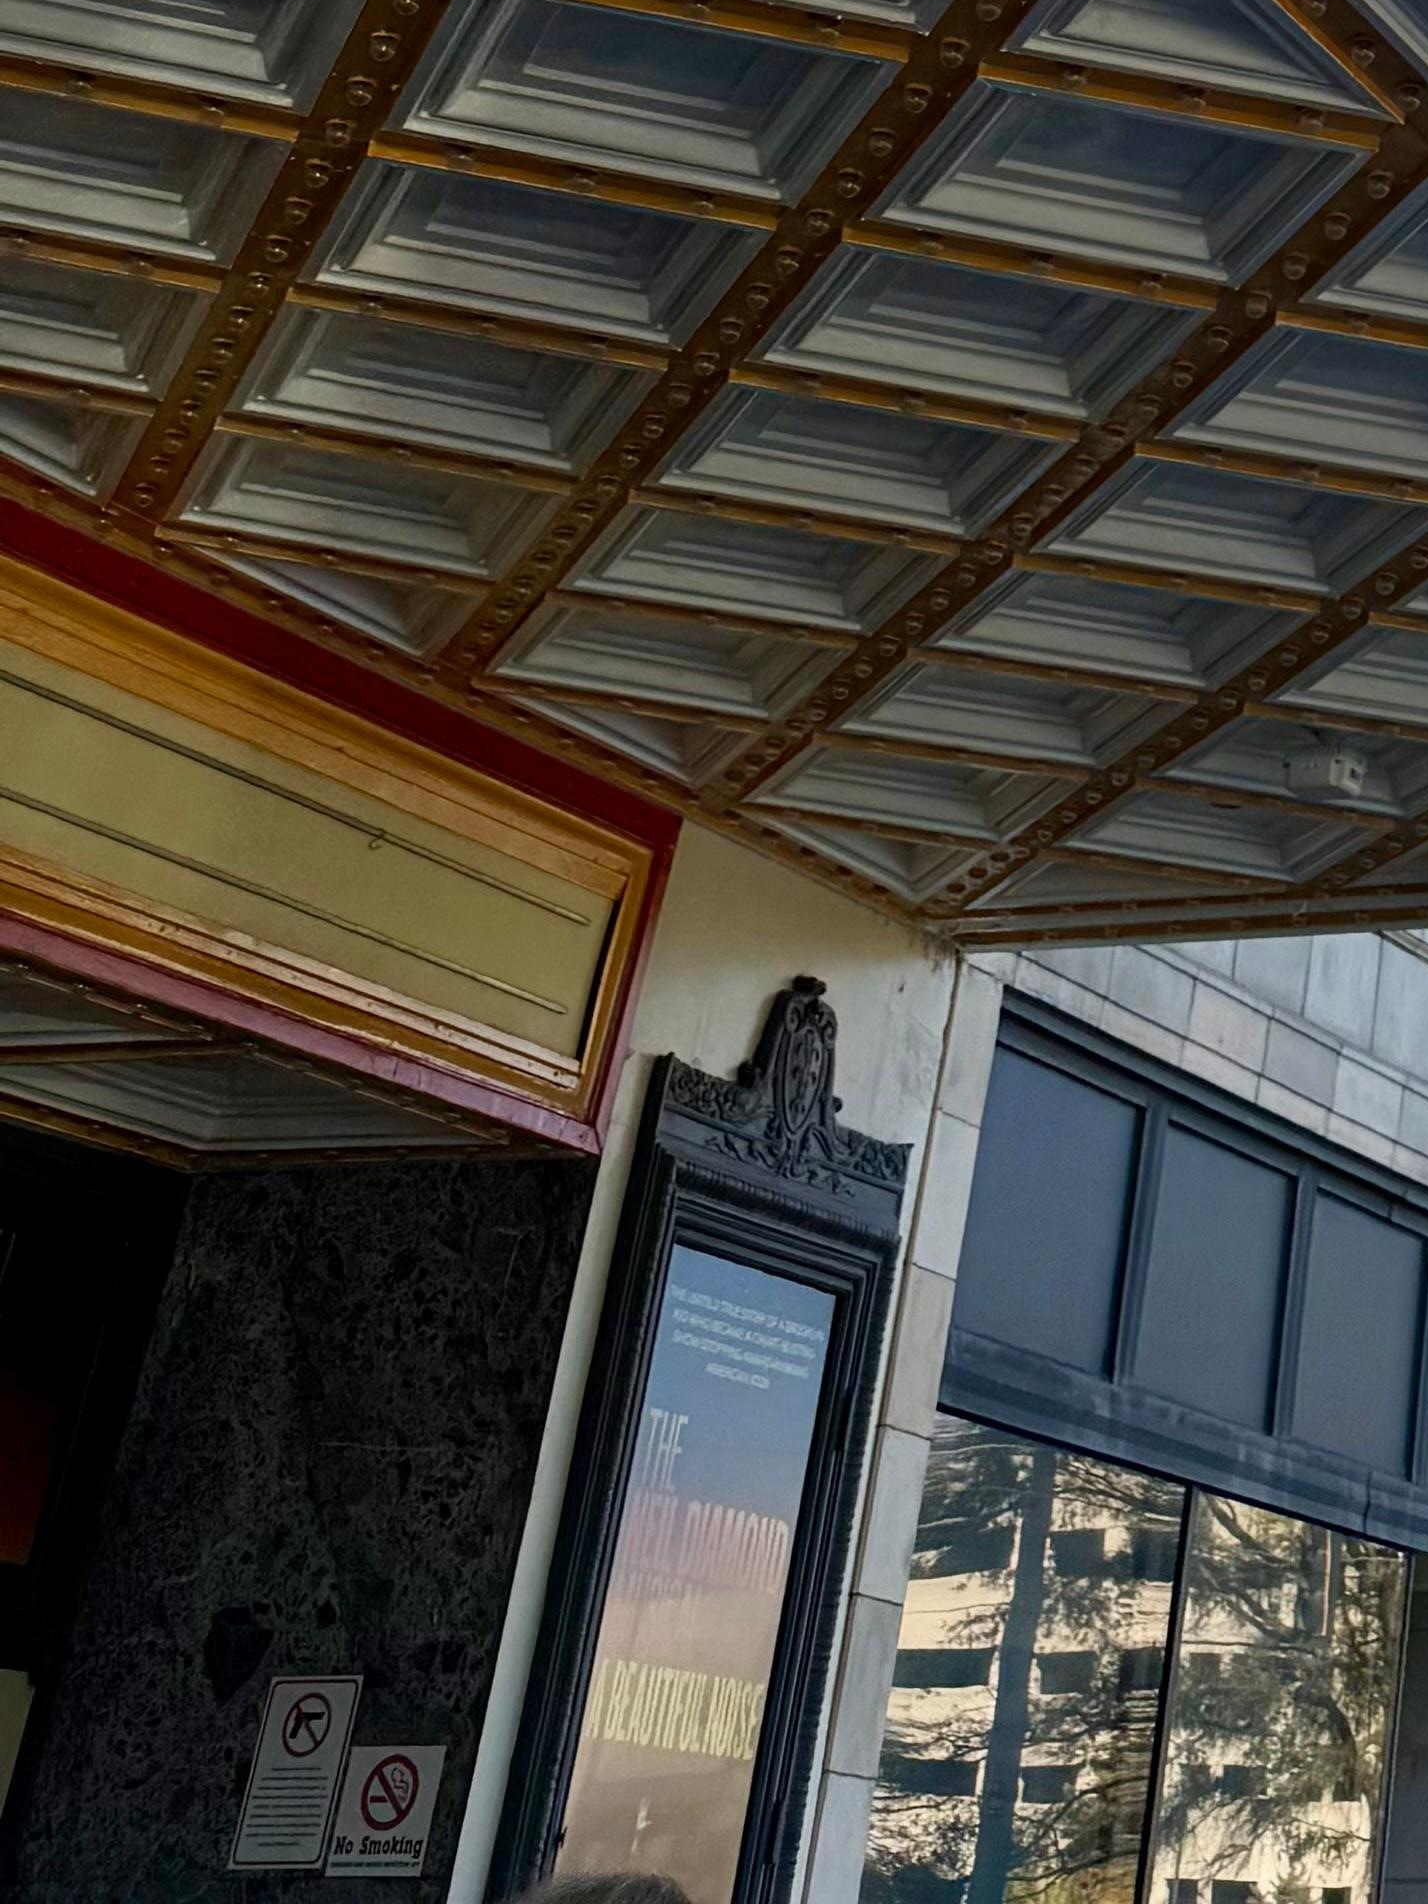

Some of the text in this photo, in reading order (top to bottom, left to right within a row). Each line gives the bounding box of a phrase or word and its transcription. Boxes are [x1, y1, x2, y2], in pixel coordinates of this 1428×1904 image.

[637, 1407, 689, 1493] THE
[677, 1499, 789, 1597] DIAMOND
[588, 1657, 765, 1761] A BEAUTIFUL NOISE
[333, 1835, 424, 1859] No Smoking
